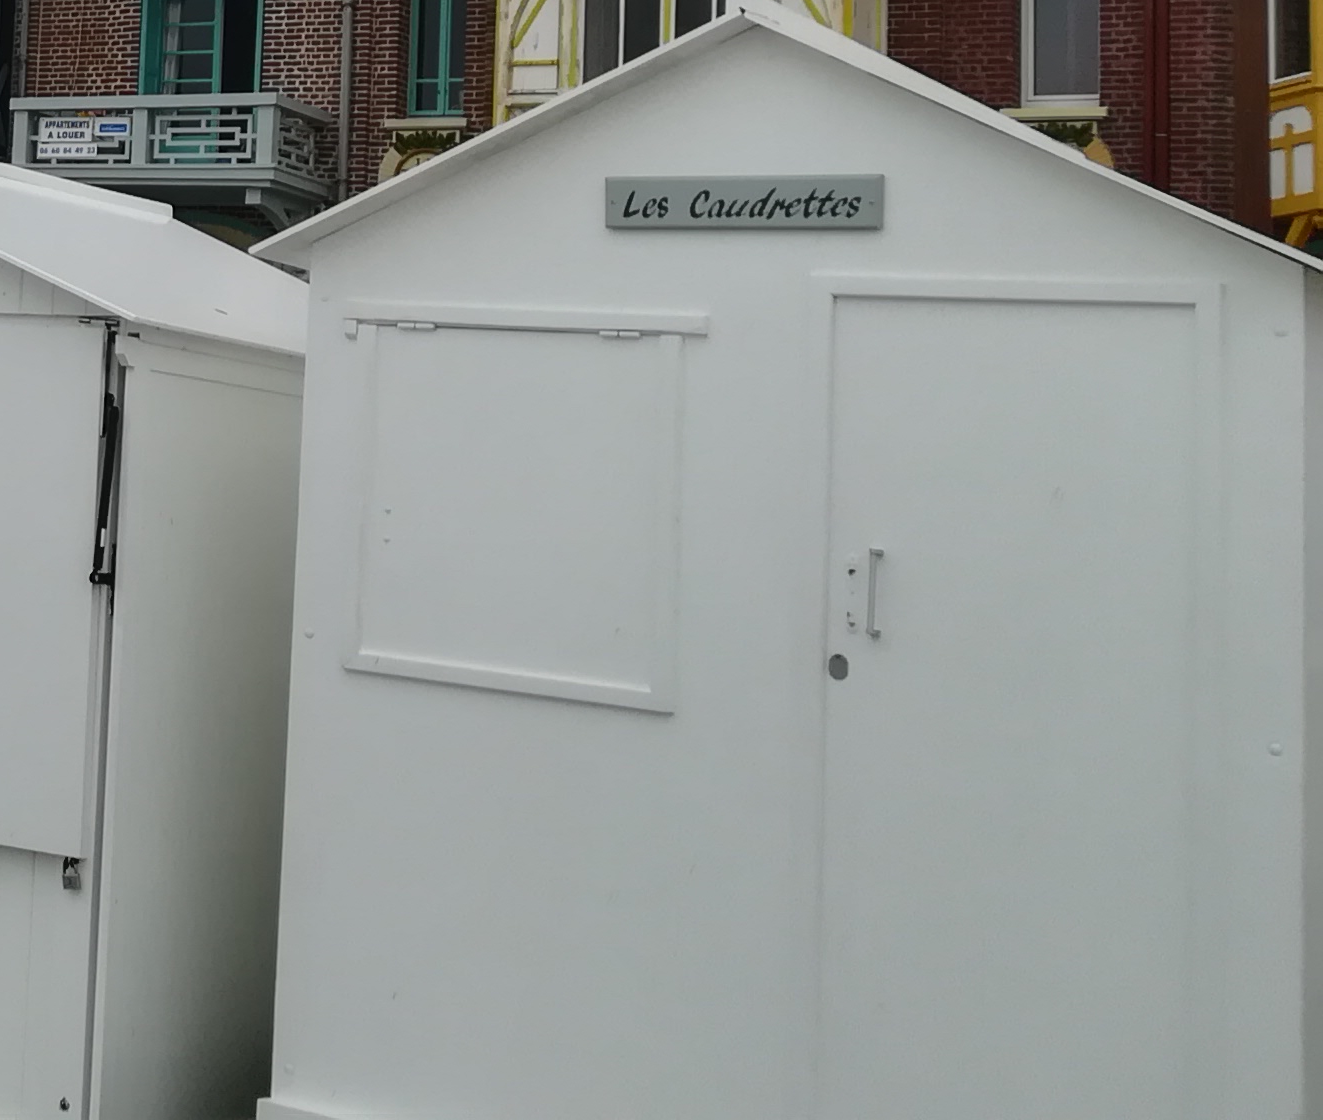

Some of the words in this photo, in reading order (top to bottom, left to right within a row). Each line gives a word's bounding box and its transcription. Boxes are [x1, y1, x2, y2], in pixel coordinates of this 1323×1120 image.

[45, 121, 90, 129] APPARTEMENTS
[47, 131, 54, 139] A
[56, 131, 85, 139] LOUER
[622, 190, 669, 219] Les
[689, 187, 862, 220] Caudrettes
